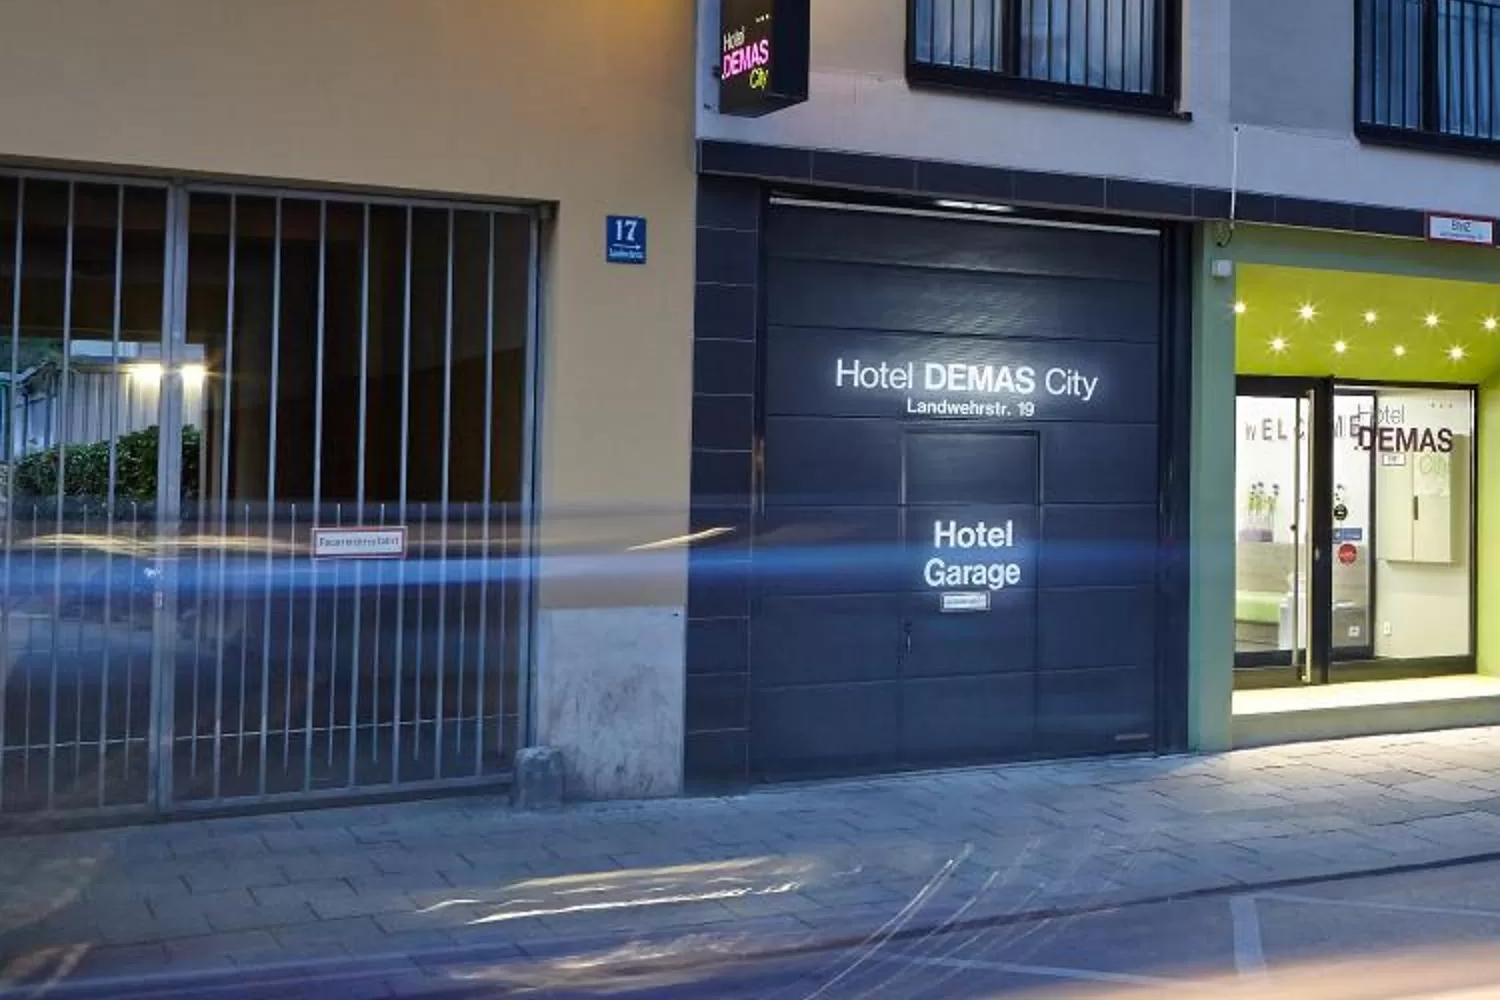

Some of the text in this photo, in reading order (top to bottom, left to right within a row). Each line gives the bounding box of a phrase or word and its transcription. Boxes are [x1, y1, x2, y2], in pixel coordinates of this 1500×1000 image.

[723, 39, 769, 78] DEMAS
[615, 219, 639, 242] 17
[835, 357, 1099, 401] Hotel DEMAS City
[906, 397, 1036, 417] Landwehrstr. 19
[1357, 403, 1405, 425] Hotel
[1245, 413, 1361, 441] WELCME
[1358, 426, 1454, 453] DEMAS
[933, 519, 1014, 549] Hotel
[923, 557, 1021, 589] Garage
